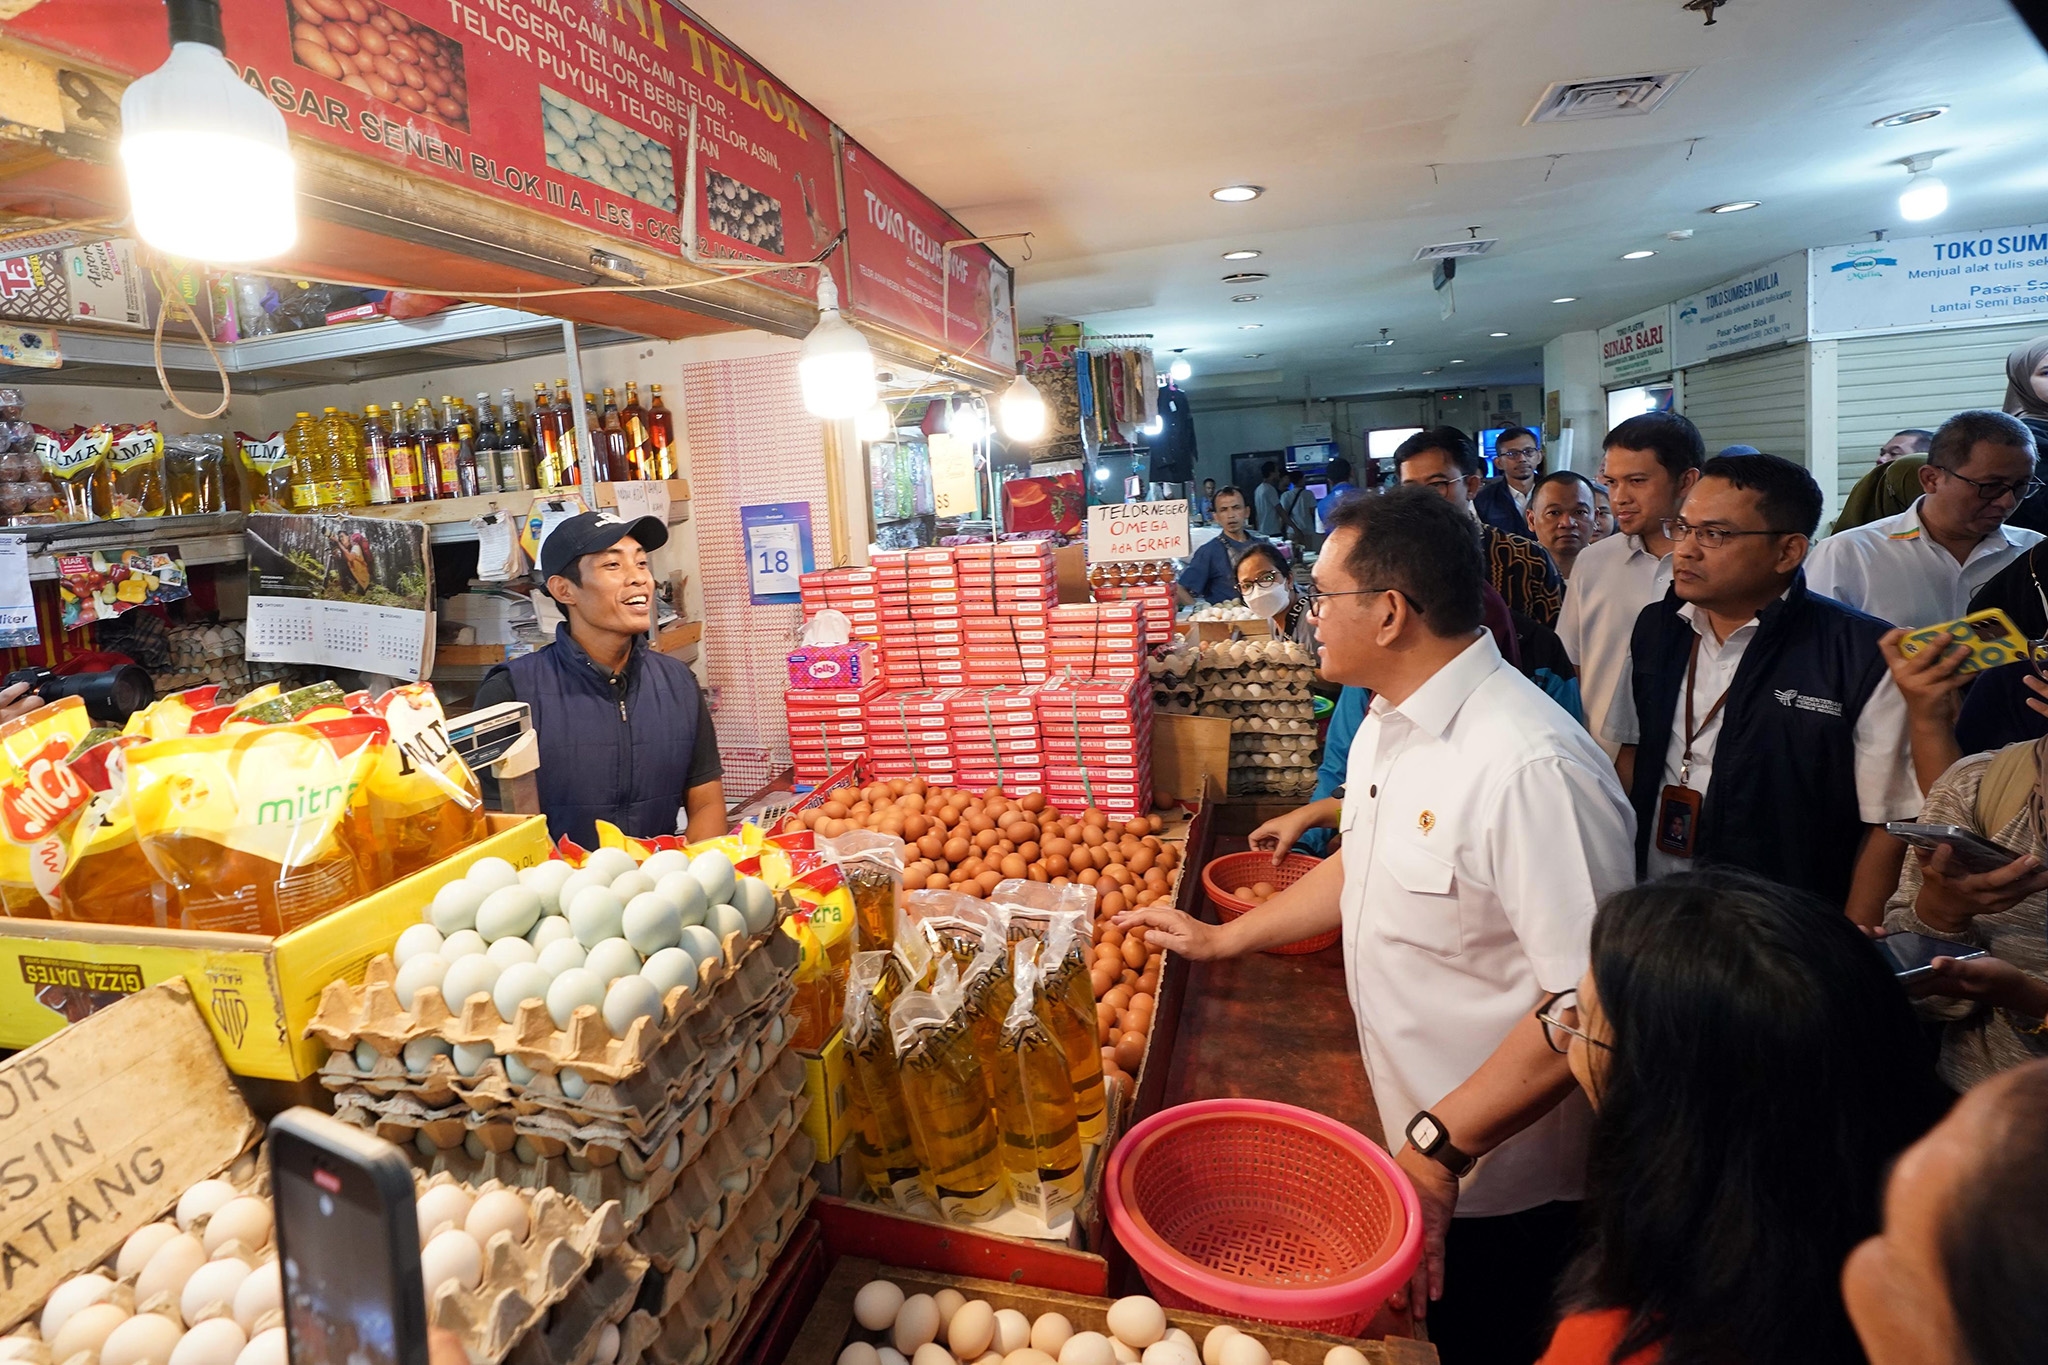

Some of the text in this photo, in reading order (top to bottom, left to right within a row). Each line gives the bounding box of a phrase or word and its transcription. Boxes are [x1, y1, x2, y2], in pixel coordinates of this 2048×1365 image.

[449, 0, 720, 160] TELOR PUYUH, TELOR PTAN
[612, 35, 676, 89] MACAM
[678, 76, 727, 119] TELOR
[680, 20, 808, 142] TELOR
[575, 40, 640, 93] TELOR
[704, 115, 749, 153] TELOR
[751, 142, 781, 173] ASIN,
[360, 110, 465, 172] SENEN
[470, 153, 543, 200] BLOK
[546, 180, 565, 208] III
[571, 190, 590, 216] A.
[596, 199, 634, 230] LBS
[647, 218, 681, 246] CKS
[864, 189, 904, 242] TOKO
[907, 221, 943, 269] TELUR
[1934, 238, 1993, 261] TOKO
[1908, 266, 1960, 280] Menjual
[1965, 263, 1989, 274] alat
[1994, 260, 2024, 271] tulis
[1706, 272, 1779, 310] TOKO SUMBER MULIA
[1931, 300, 1971, 314] Lantai
[1975, 297, 2009, 309] Semi
[1717, 328, 1732, 338] Pasar
[1733, 322, 1752, 334] Senen
[1753, 315, 1767, 328] Blok
[1604, 336, 1634, 359] SINAR
[1636, 325, 1664, 350] SARI
[34, 441, 102, 466] FILMA
[1099, 504, 1150, 521] TELOR
[1110, 520, 1169, 535] OMEGA
[760, 550, 789, 574] 18
[813, 663, 836, 676] jolly
[26, 965, 141, 993] GIZZA DATES
[1, 1145, 164, 1291] ATANG
